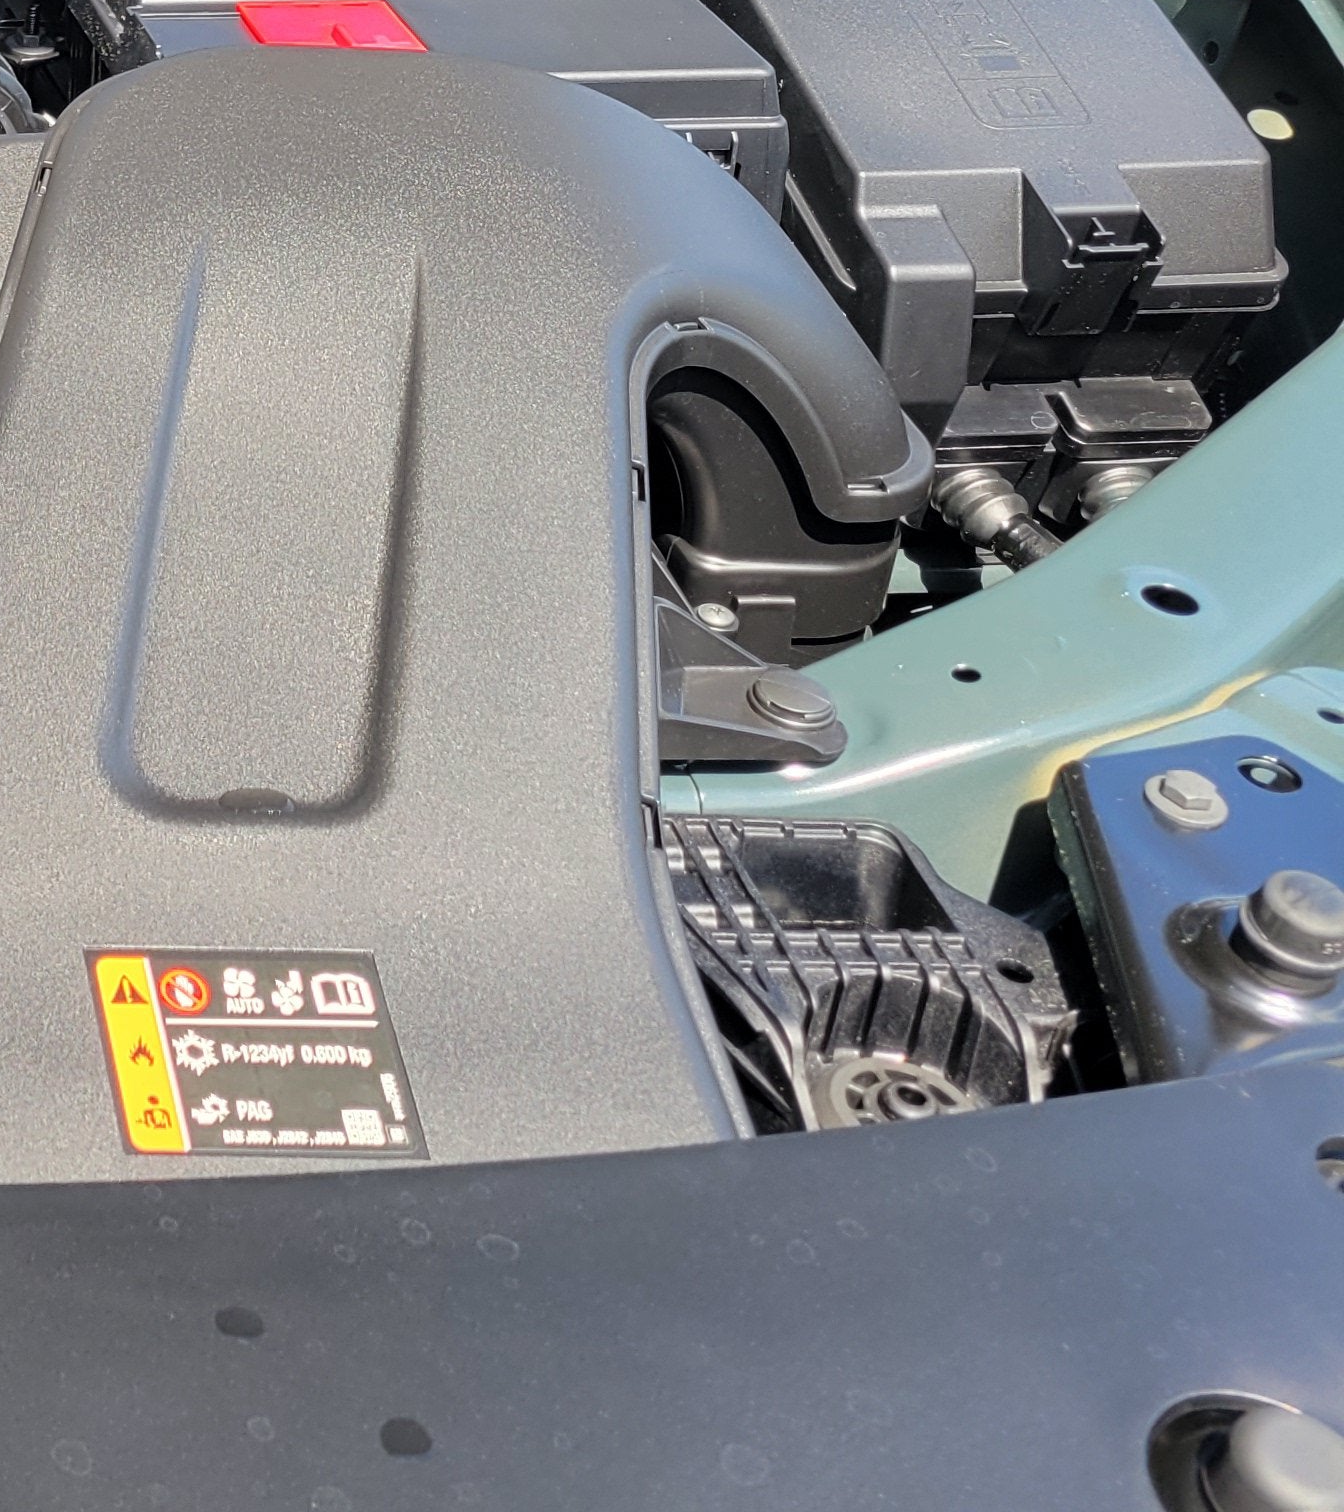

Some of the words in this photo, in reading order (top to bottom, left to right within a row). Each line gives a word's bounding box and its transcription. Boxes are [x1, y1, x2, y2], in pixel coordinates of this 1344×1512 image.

[226, 996, 264, 1015] AUTO
[221, 1042, 295, 1067] R-1234yf
[347, 1045, 373, 1068] kg
[236, 1098, 273, 1123] PAG
